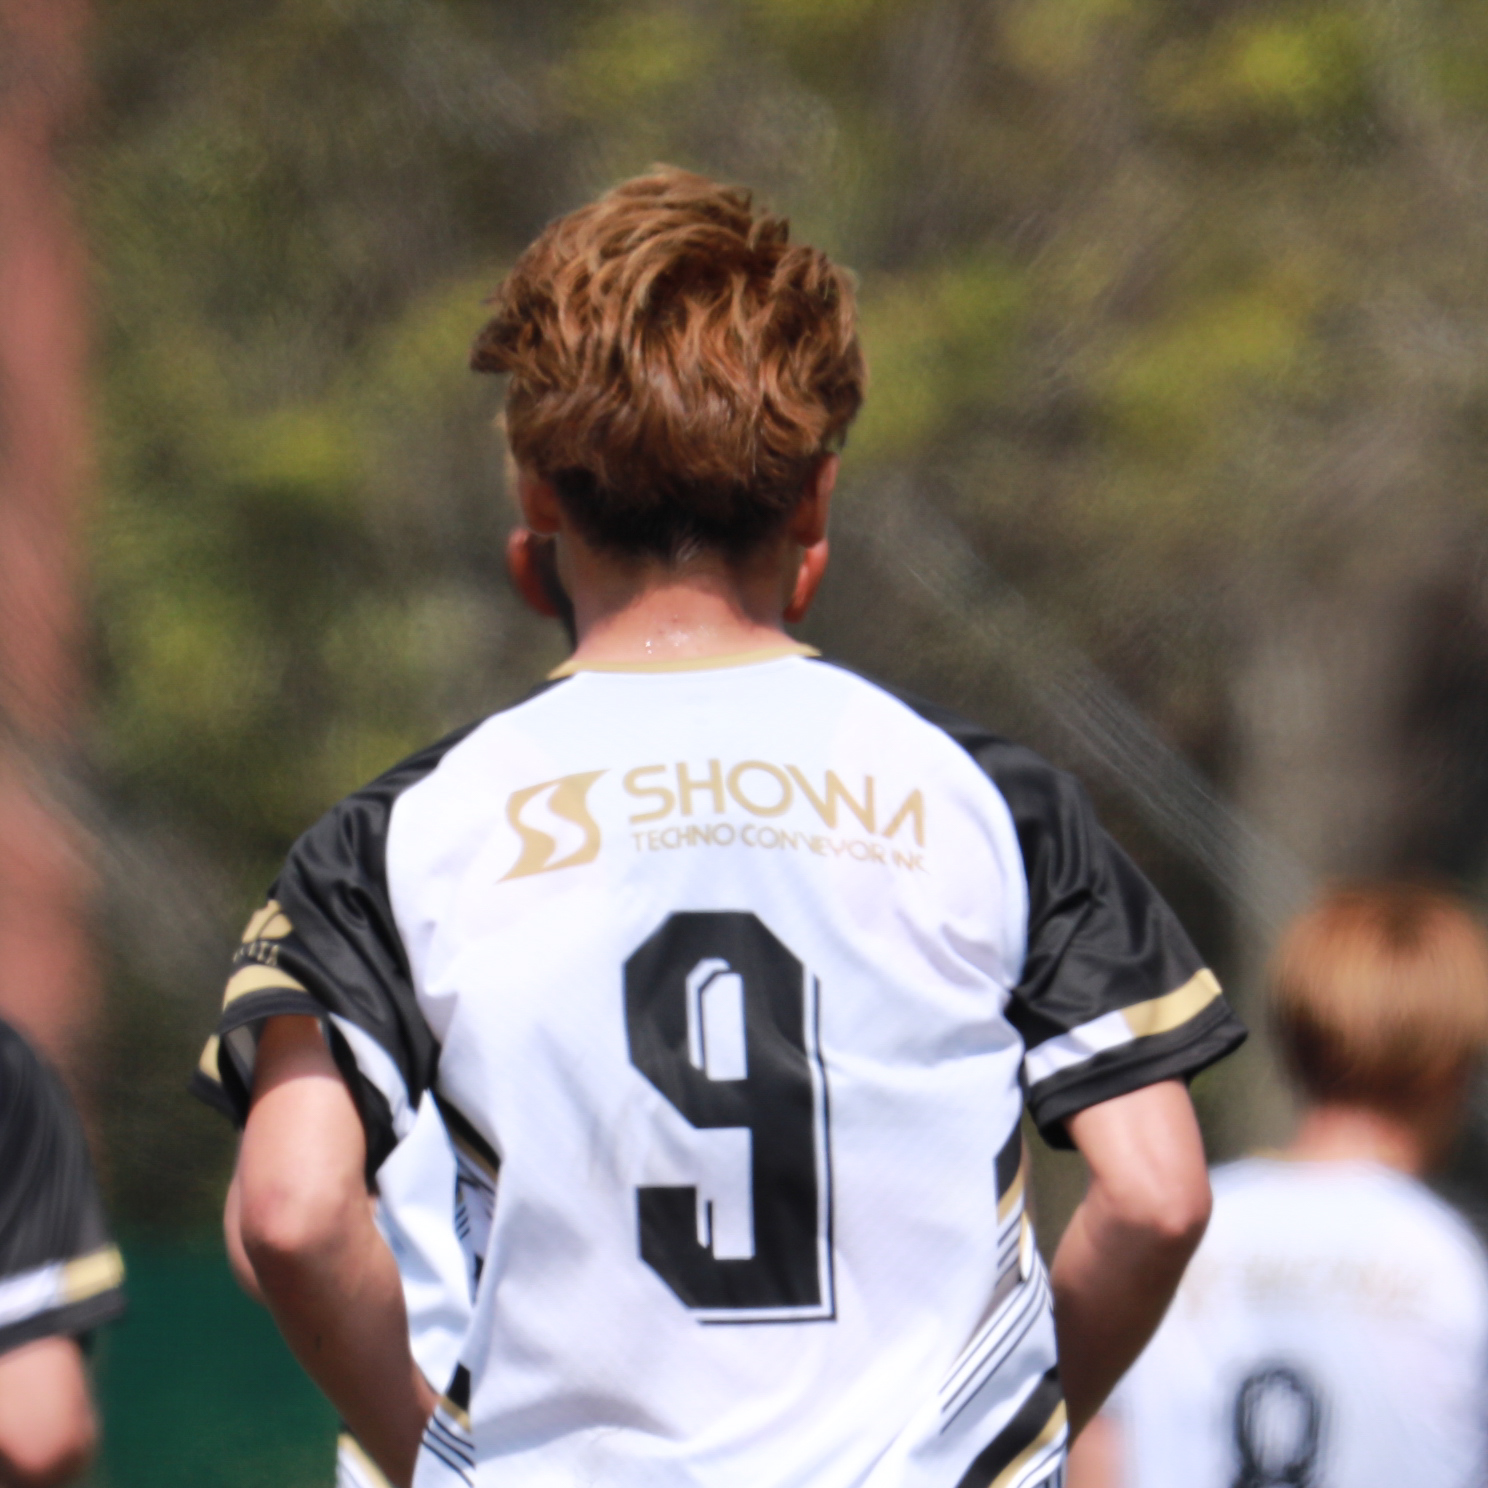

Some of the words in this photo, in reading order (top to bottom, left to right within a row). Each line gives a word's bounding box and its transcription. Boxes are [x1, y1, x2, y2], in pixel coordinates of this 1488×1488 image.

[622, 758, 925, 847] SHOWA
[632, 822, 736, 851] TECHNO
[621, 910, 839, 1324] 9
